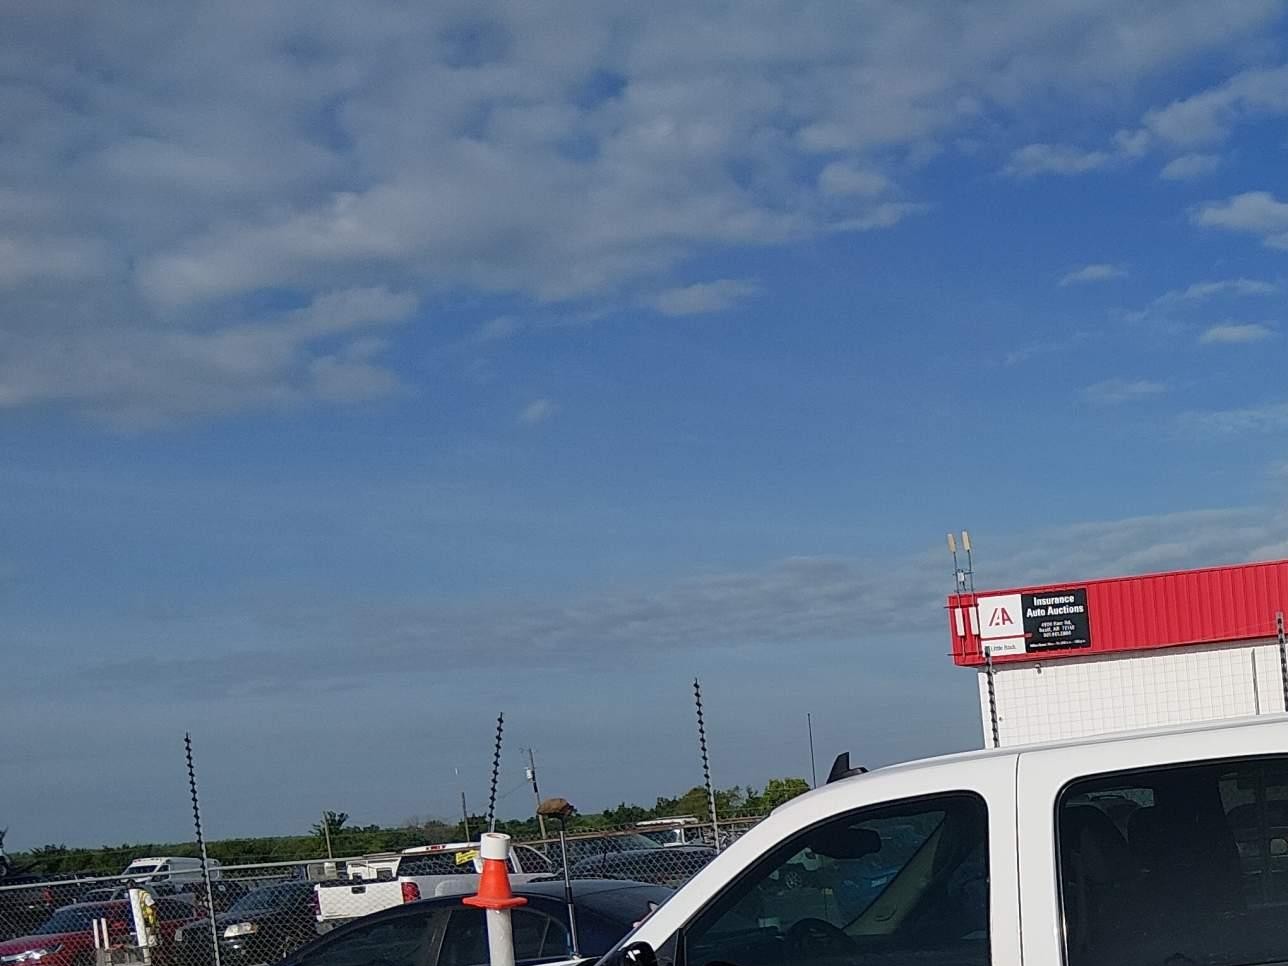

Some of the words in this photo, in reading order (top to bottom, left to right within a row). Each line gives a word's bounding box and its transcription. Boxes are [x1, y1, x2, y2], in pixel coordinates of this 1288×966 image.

[1033, 595, 1075, 606] Insurance
[1026, 608, 1046, 618] Auto
[1047, 604, 1085, 616] Auctions
